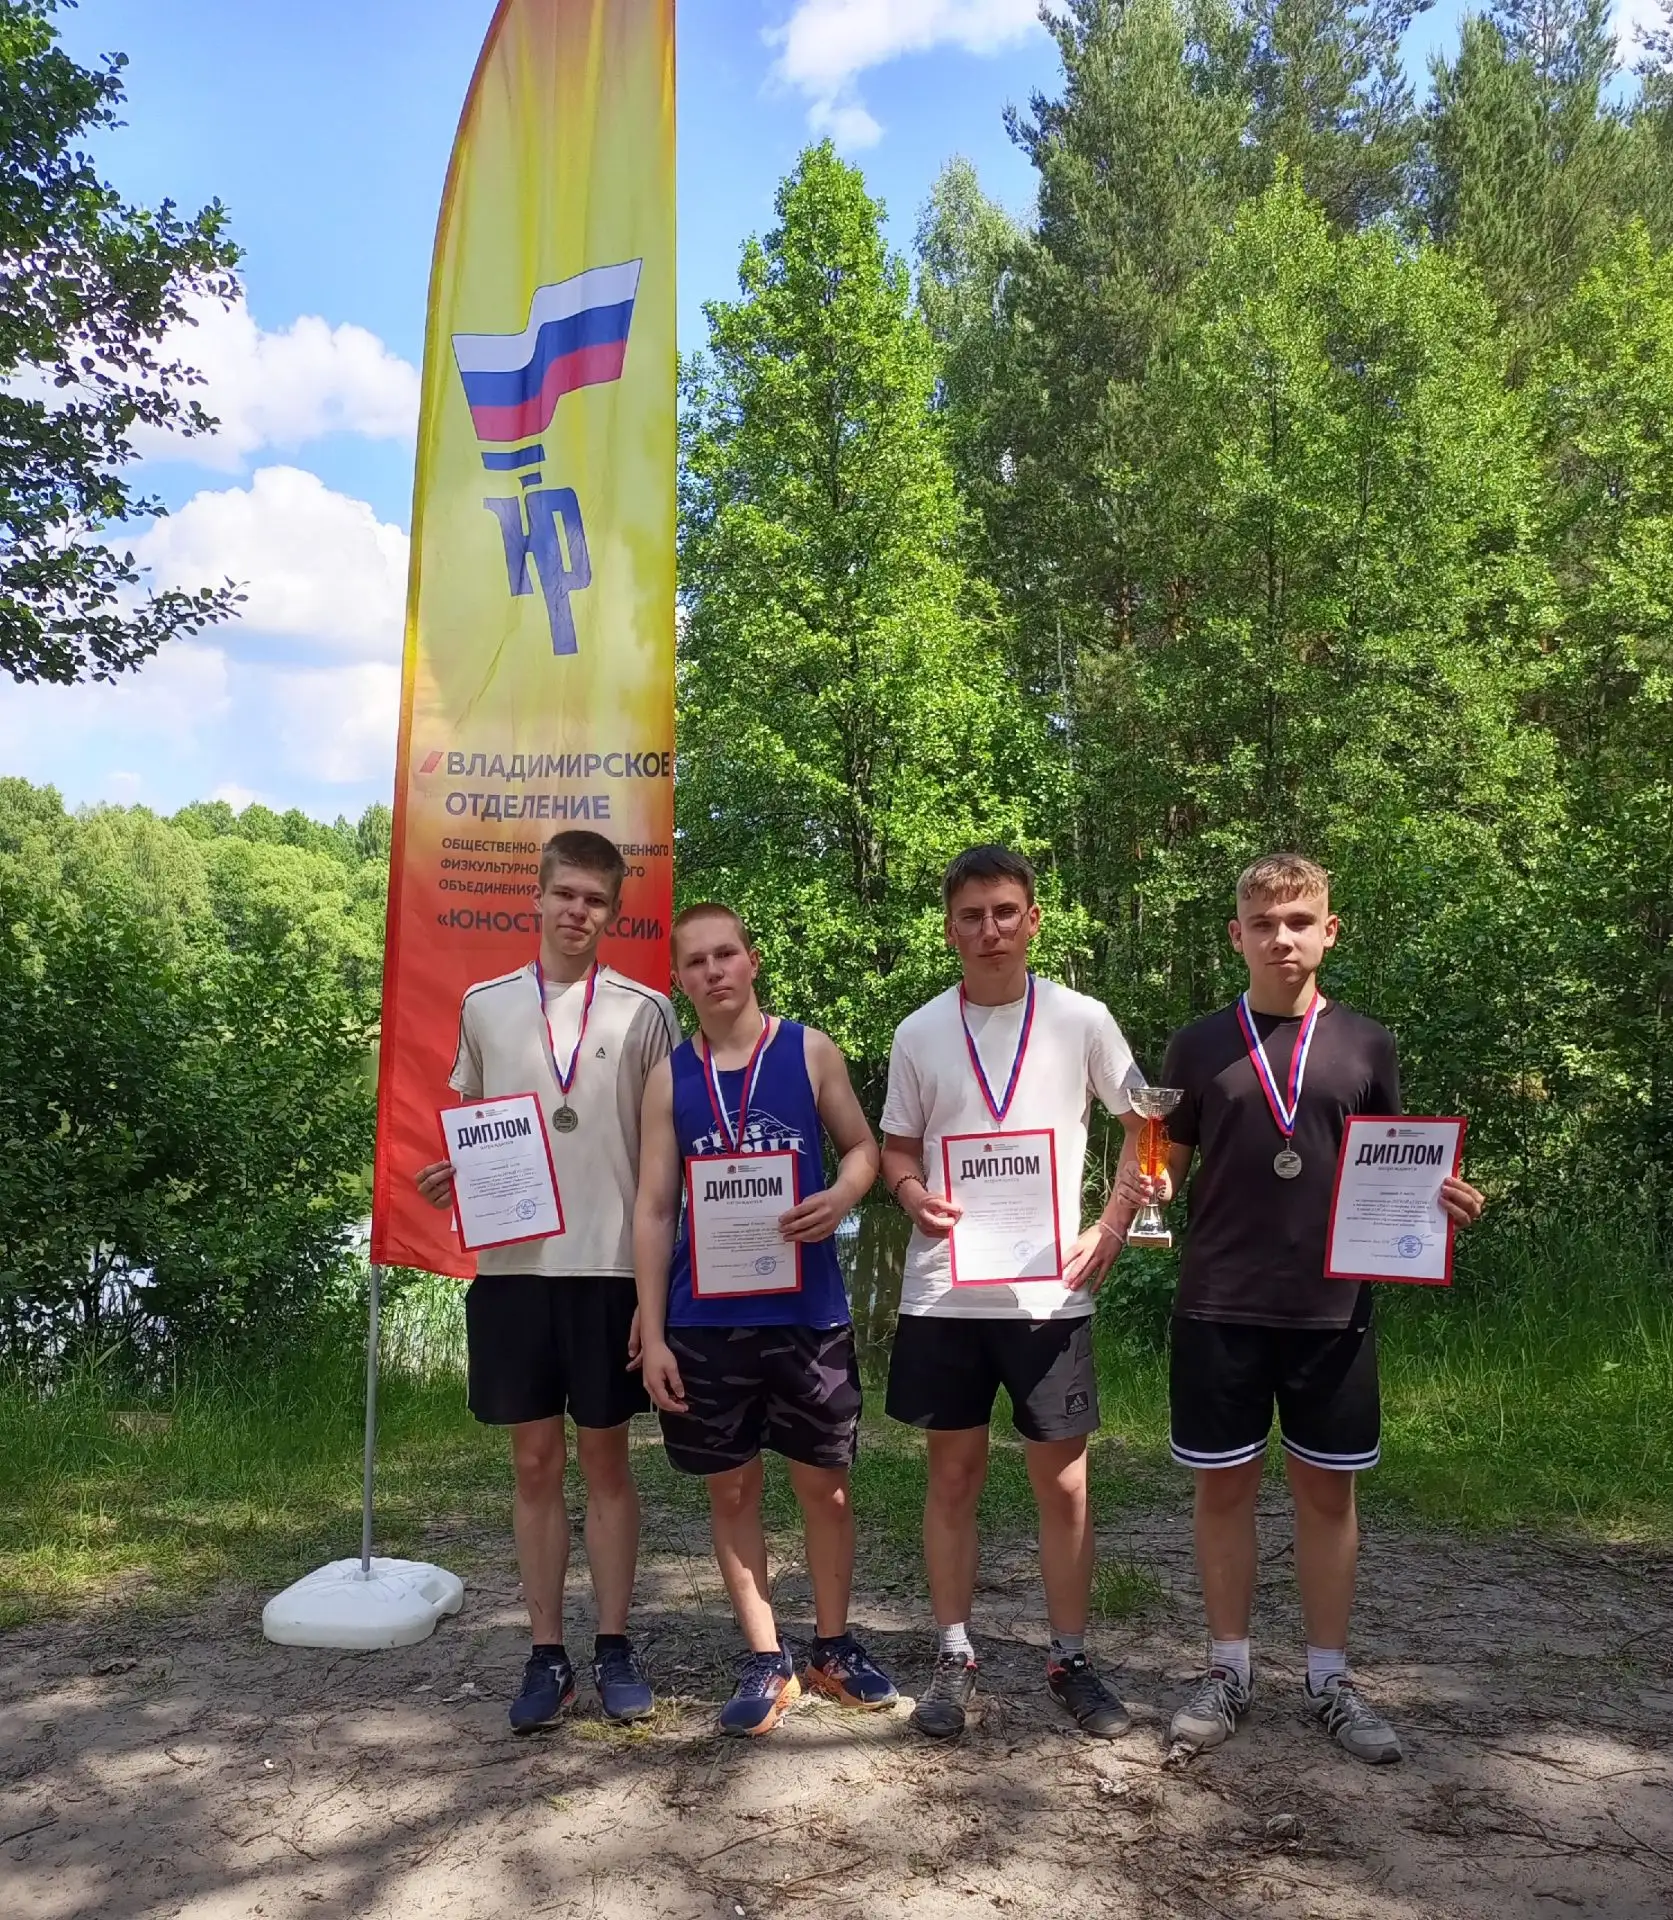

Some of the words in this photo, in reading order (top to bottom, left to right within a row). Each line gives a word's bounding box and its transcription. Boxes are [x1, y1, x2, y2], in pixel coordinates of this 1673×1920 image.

[447, 751, 670, 783] ВЛАДИМИРСКОЕ
[445, 791, 611, 822] ОТДЕЛЕНИЕ
[437, 908, 543, 934] «ЮНОСТ
[457, 1116, 532, 1150] ДИПЛОМ
[960, 1155, 1040, 1180] ДИПЛОМ
[1355, 1143, 1444, 1166] ДИПЛОМ
[703, 1176, 783, 1202] ДИПЛОМ
